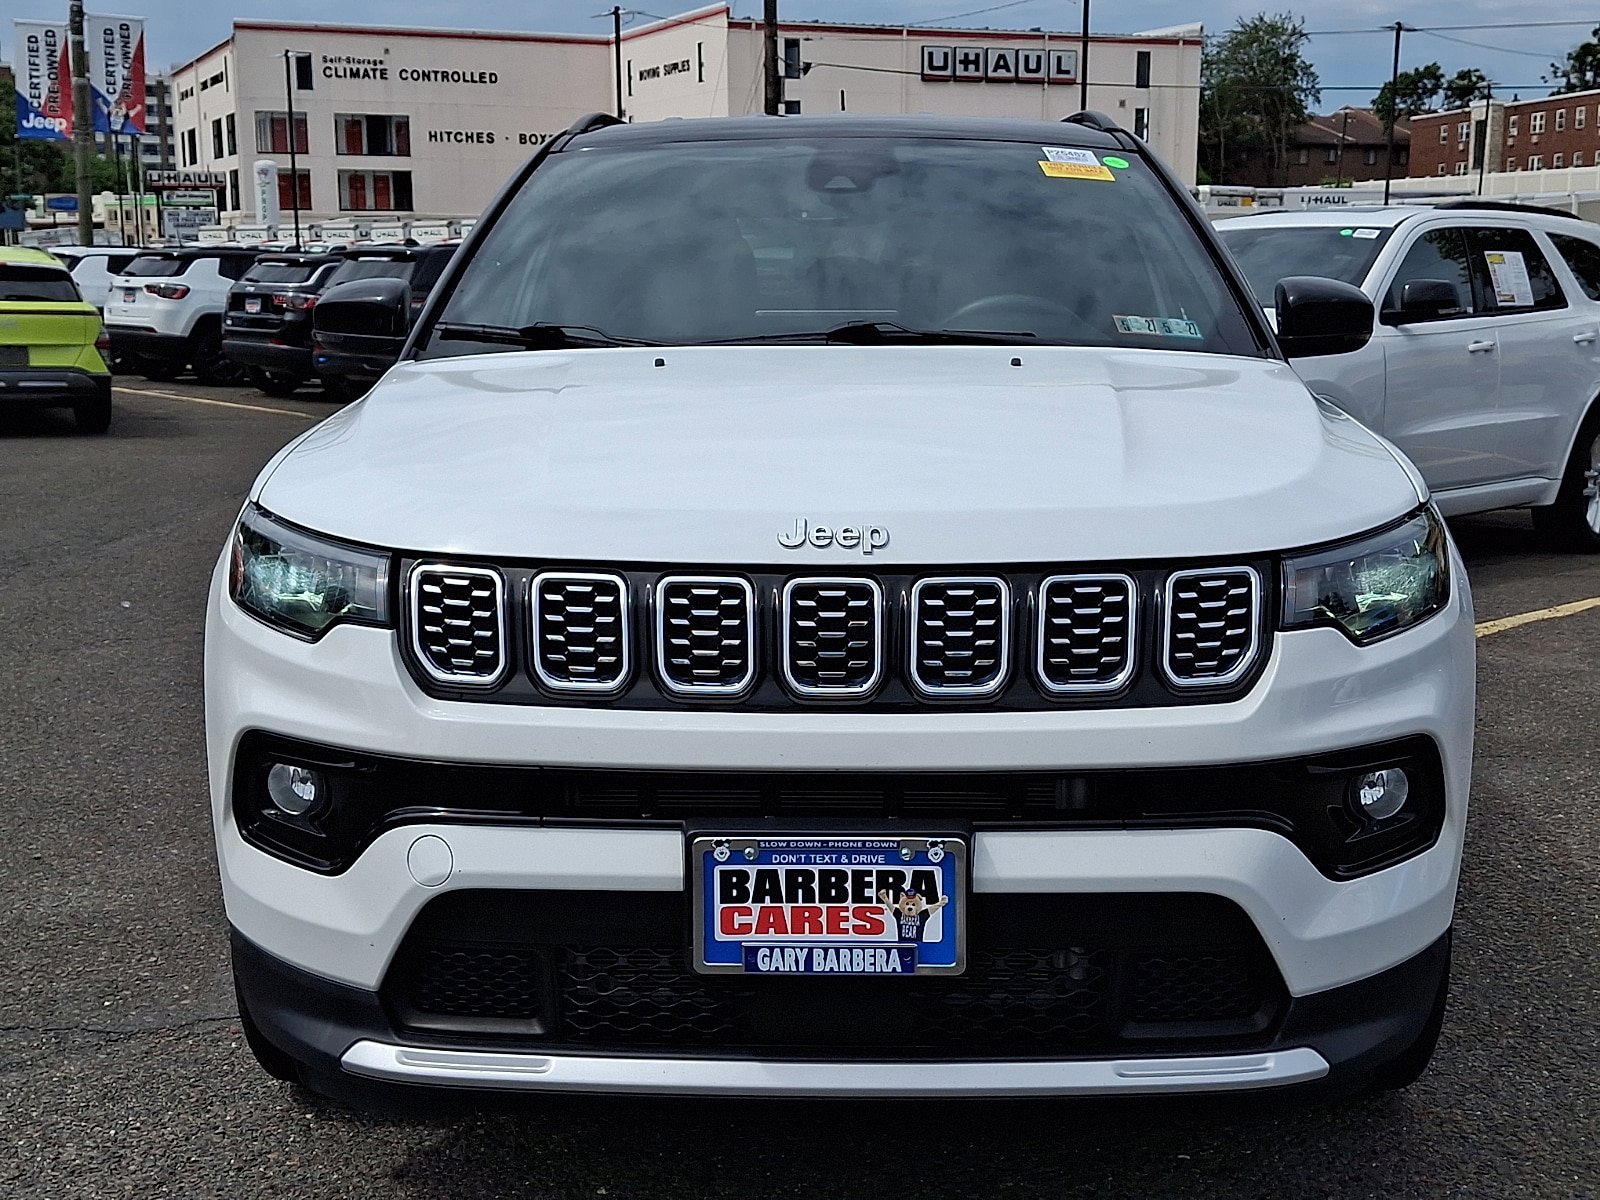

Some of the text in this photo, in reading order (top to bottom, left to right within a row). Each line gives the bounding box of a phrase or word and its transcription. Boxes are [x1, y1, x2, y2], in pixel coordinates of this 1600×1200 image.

[103, 27, 117, 95] CERTIFIED
[663, 59, 690, 76] SUPPLIES
[27, 34, 41, 109] CERTIFIED
[322, 66, 498, 84] CLIMATE CONTROLLED
[22, 112, 67, 132] Jeep
[428, 131, 495, 144] HITCHES
[518, 133, 554, 145] BOX
[1121, 320, 1130, 331] 5
[1163, 322, 1171, 334] 5
[777, 517, 890, 555] Jeep
[772, 854, 885, 863] DON'T TEXT & DRIVE
[719, 868, 939, 905] BARBERA
[720, 906, 887, 936] CARES
[901, 925, 917, 938] BEAR
[757, 948, 902, 972] GARY BARBERA
